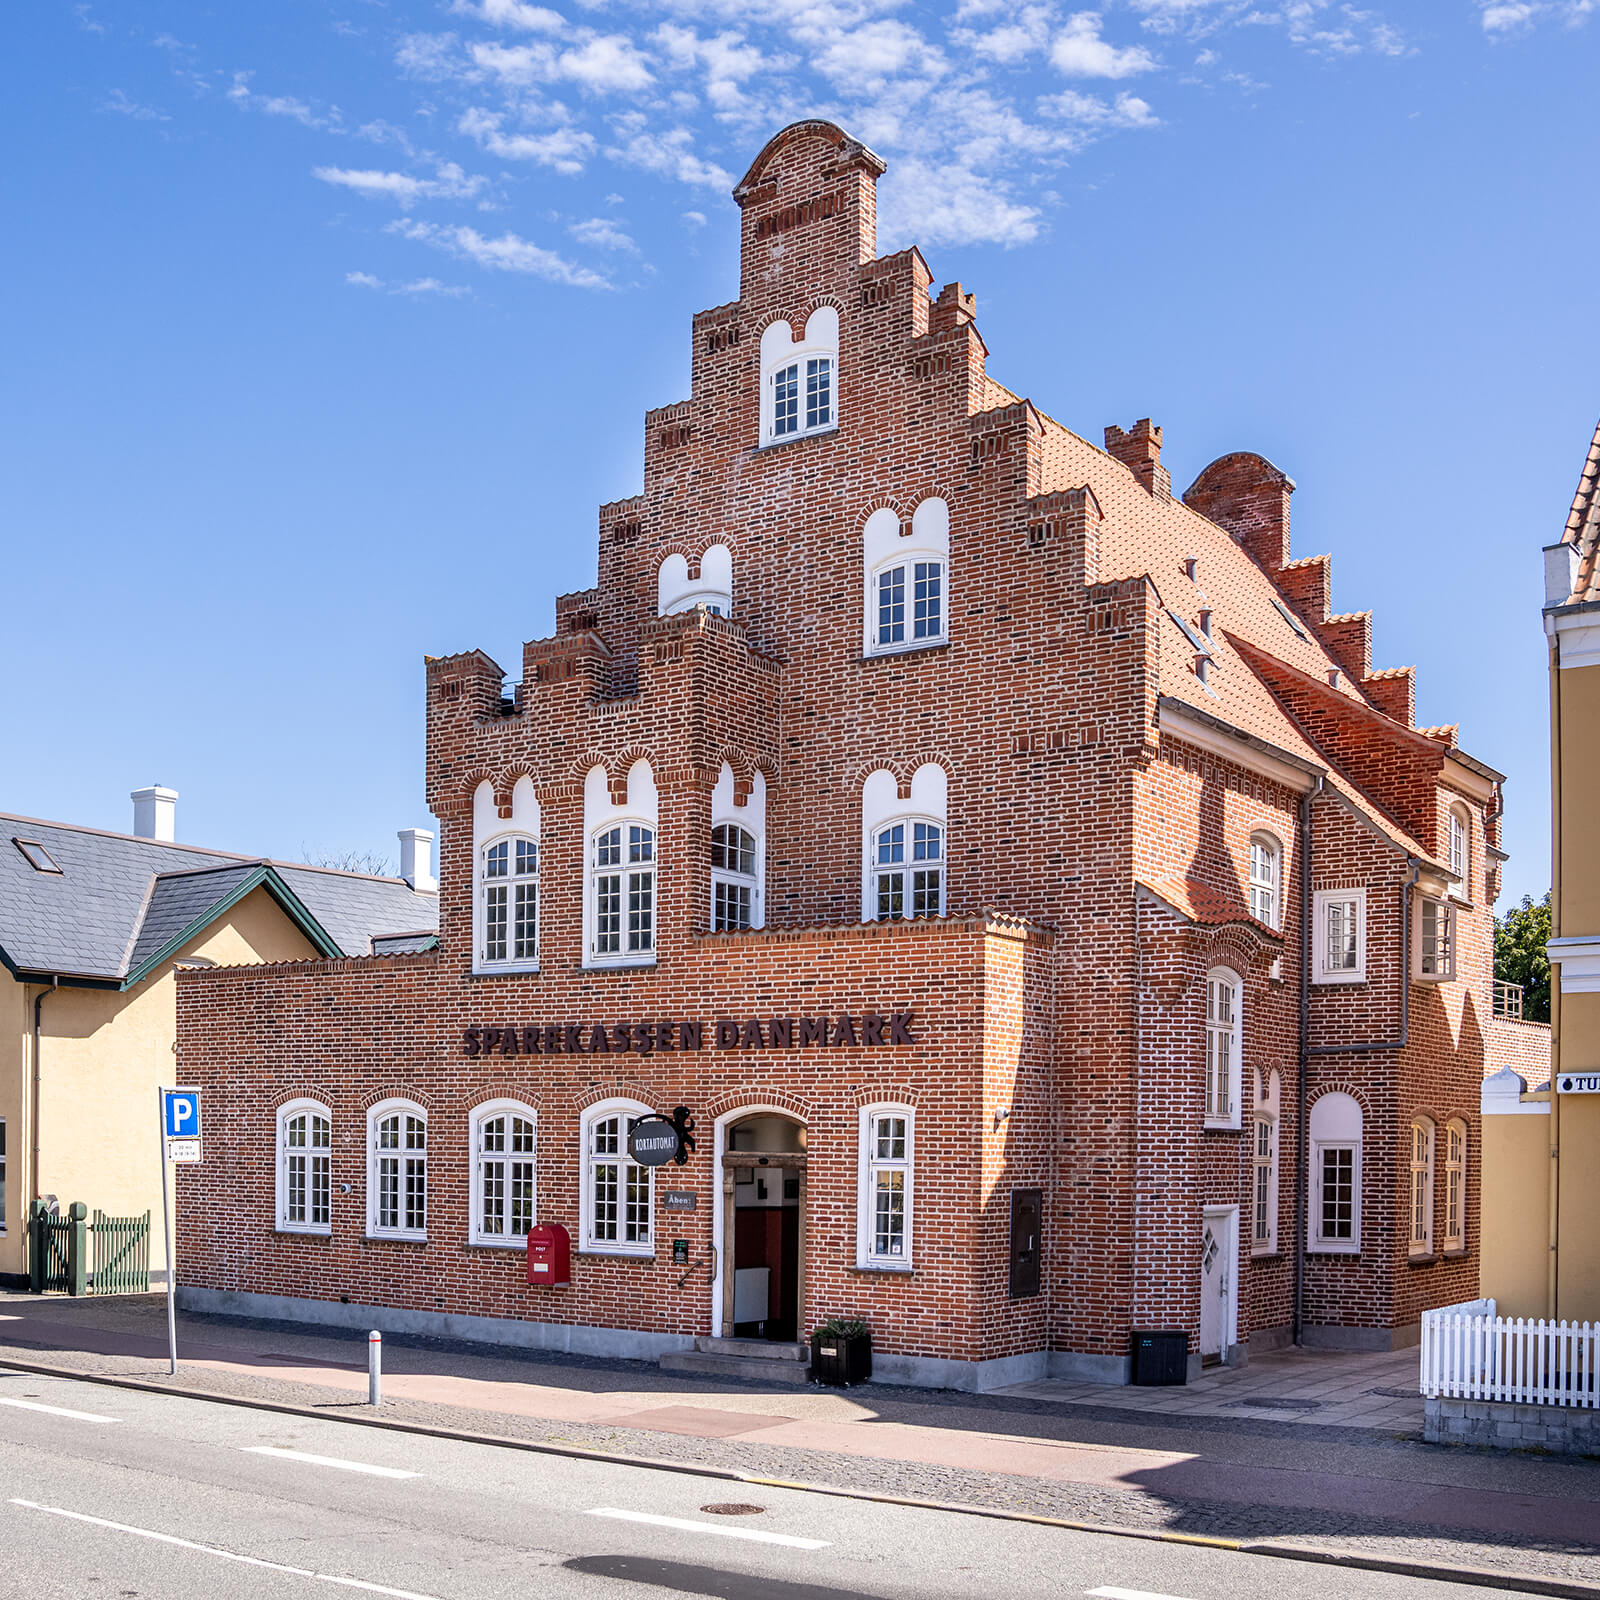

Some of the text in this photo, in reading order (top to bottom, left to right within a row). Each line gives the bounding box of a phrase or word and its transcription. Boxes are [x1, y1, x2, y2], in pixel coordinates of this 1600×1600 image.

[463, 1014, 915, 1054] SPAREKASSEN DANMARK
[1575, 1077, 1600, 1090] TU
[173, 1098, 192, 1132] P
[635, 1136, 675, 1151] KORTAUTOMAT
